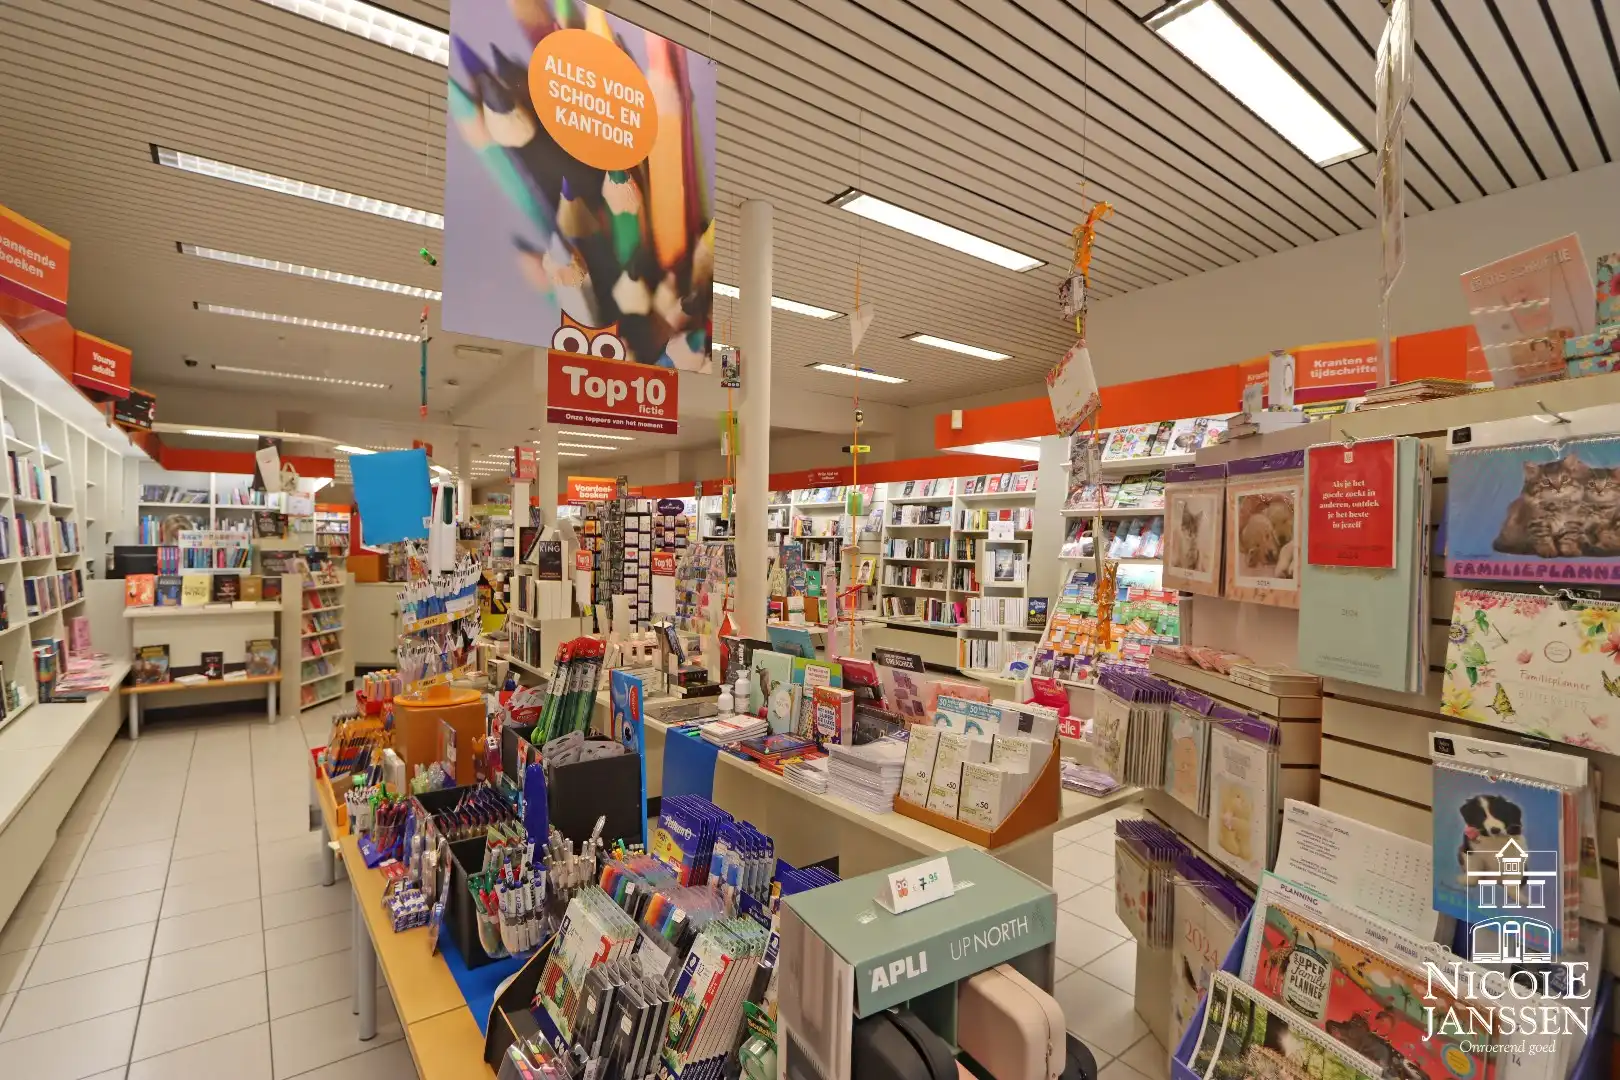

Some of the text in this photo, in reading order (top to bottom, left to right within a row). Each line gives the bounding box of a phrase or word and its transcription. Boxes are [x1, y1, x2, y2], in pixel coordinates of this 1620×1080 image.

[544, 55, 645, 109] ALLES VOOR
[548, 79, 641, 128] SCHOOL EN
[555, 105, 634, 149] KANTOOR
[92, 352, 116, 368] Young
[1313, 357, 1363, 368] Kranten
[92, 364, 116, 378] adults
[1310, 366, 1378, 379] tijdschrifte
[561, 365, 666, 407] Top 10
[638, 404, 664, 416] fictie
[565, 413, 584, 421] Onze
[585, 415, 611, 424] toppers
[625, 419, 636, 427] het
[637, 421, 664, 429] moment
[1332, 480, 1343, 488] Als
[1344, 480, 1352, 488] je
[1322, 489, 1376, 500] goede zoekt in
[1319, 499, 1380, 509] anderen, ontdek
[1341, 520, 1362, 529] jezelf
[539, 545, 560, 553] KING
[1519, 669, 1591, 691] Familieplanner
[1280, 883, 1319, 906] PLANNING
[973, 915, 1029, 954] NORTH
[870, 951, 929, 994] APLI
[1293, 953, 1325, 977] SUPER
[1291, 960, 1327, 991] Family
[1290, 975, 1322, 1001] PLANNER
[1512, 1054, 1521, 1066] 14
